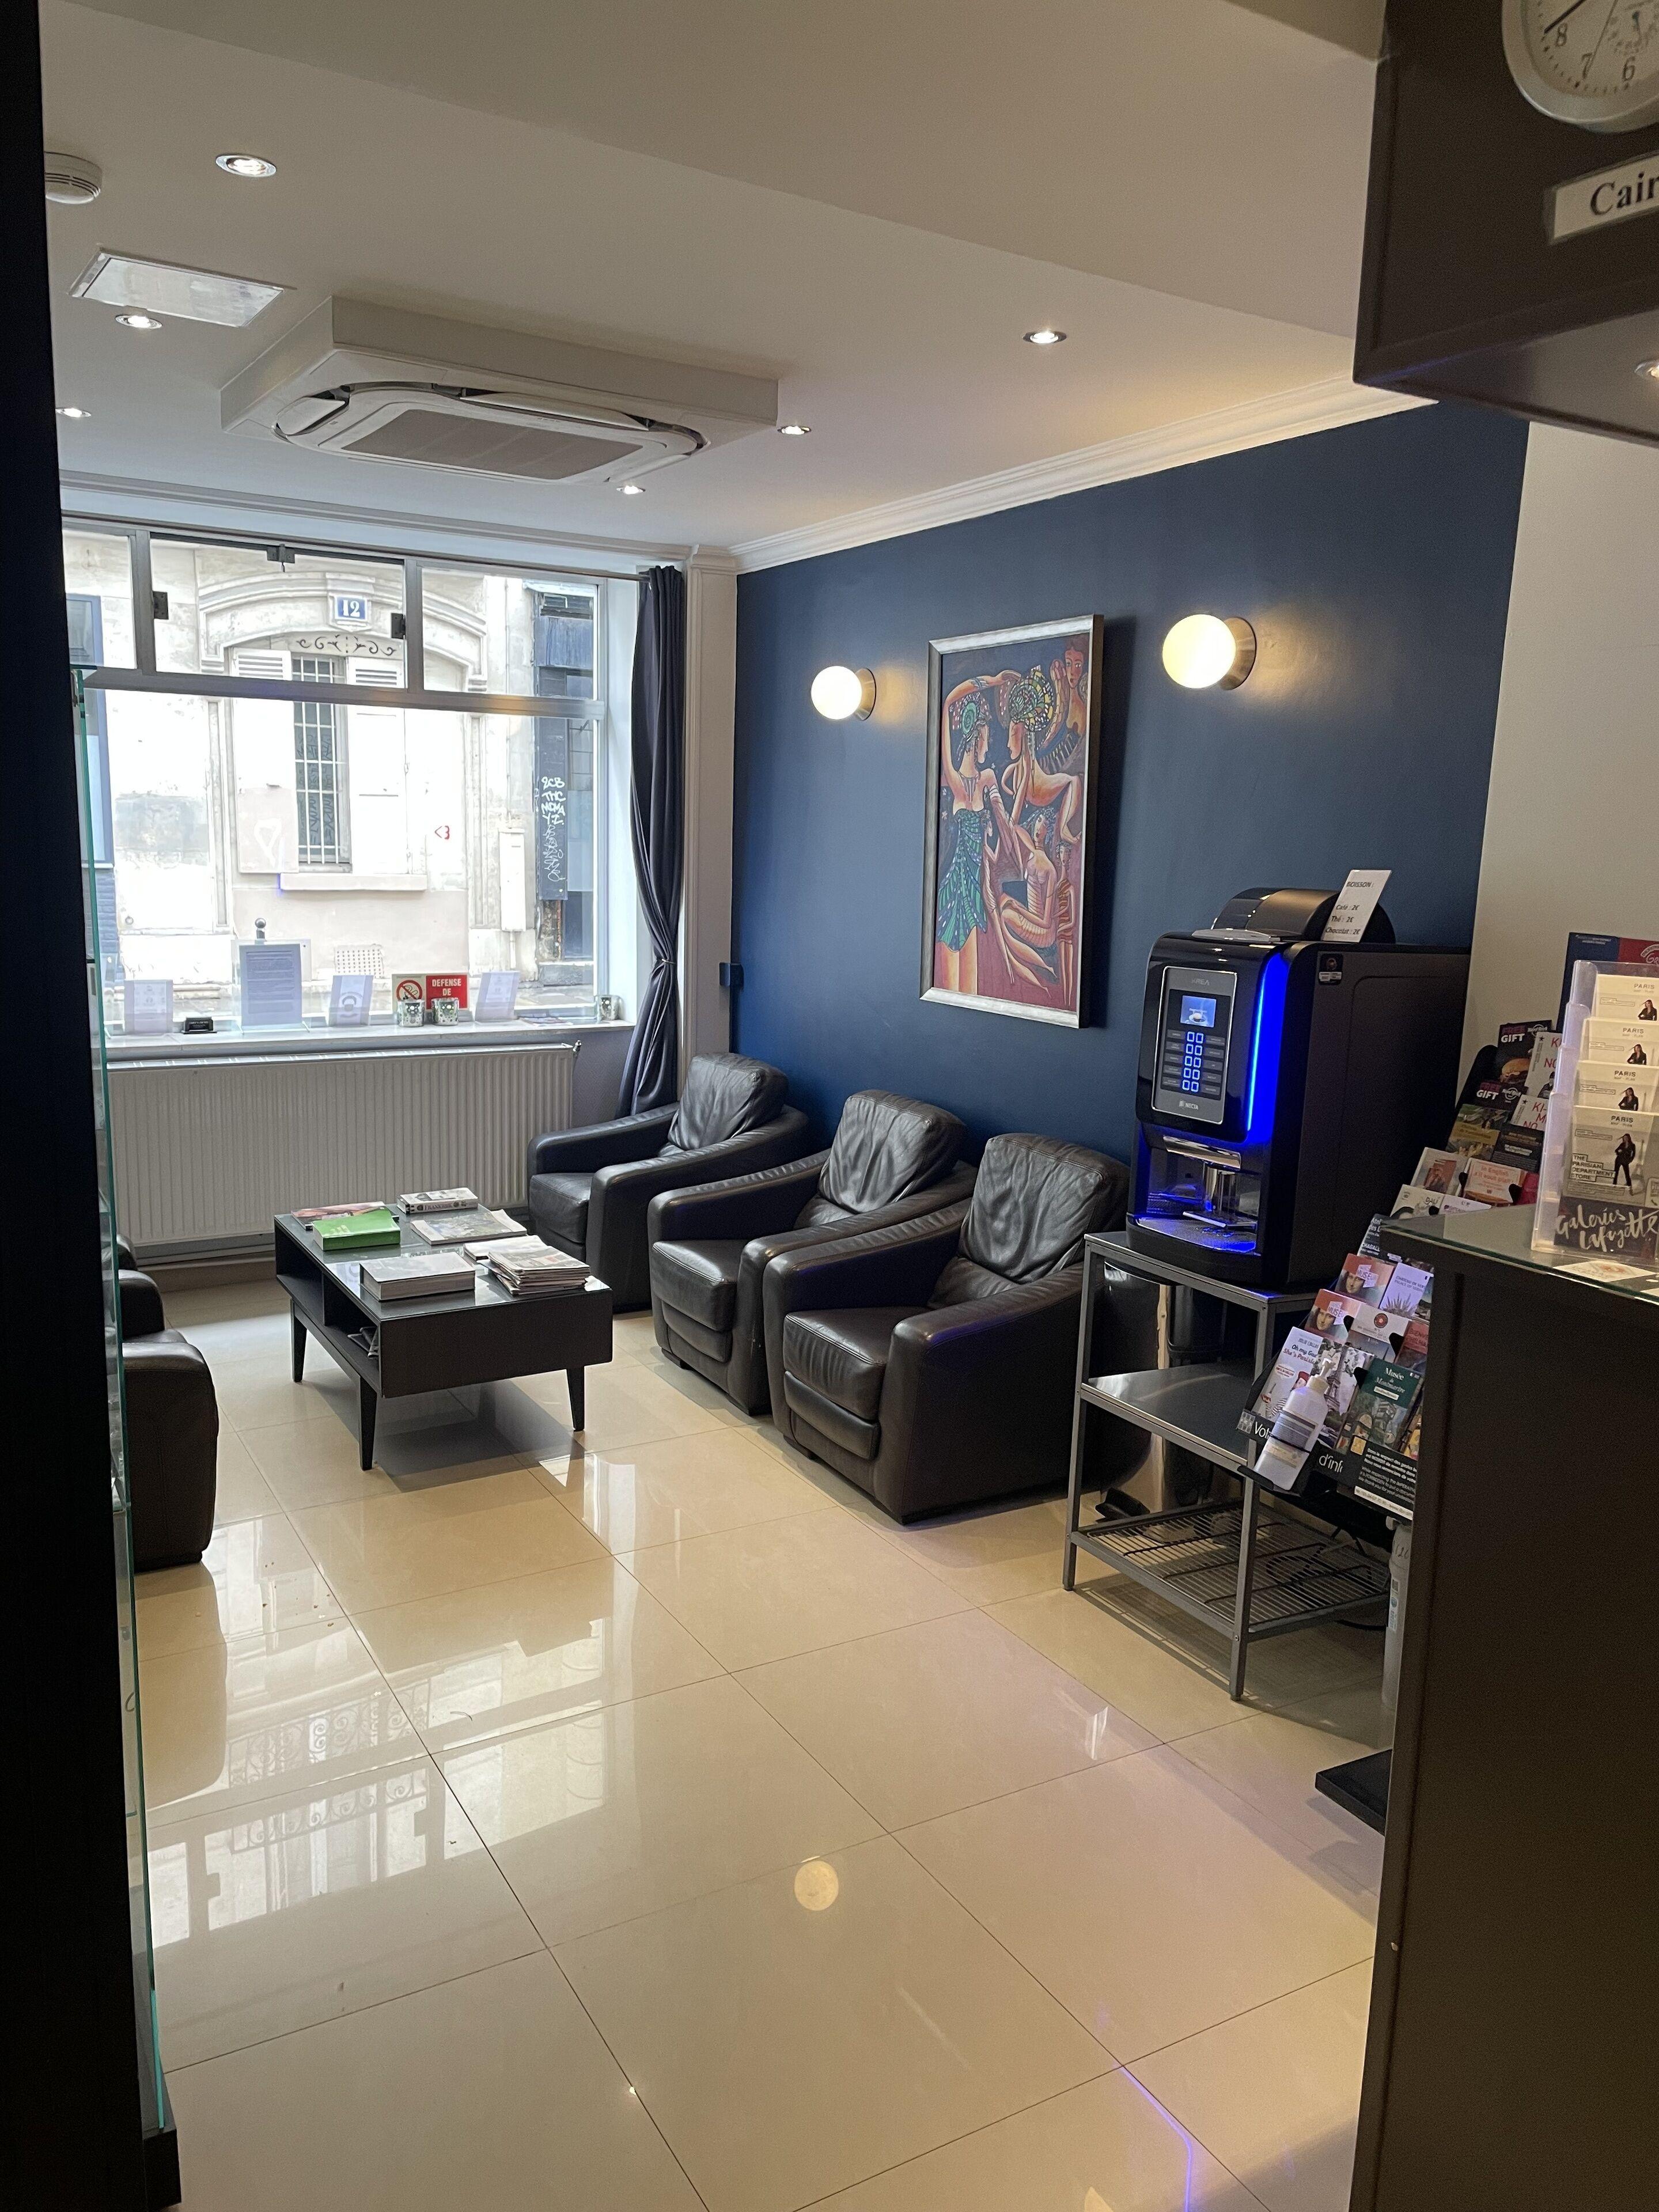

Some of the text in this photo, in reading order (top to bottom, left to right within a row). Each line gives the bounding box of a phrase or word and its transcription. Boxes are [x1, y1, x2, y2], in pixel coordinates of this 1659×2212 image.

[1555, 22, 1567, 48] 8
[1581, 53, 1593, 80] 7
[1622, 56, 1635, 82] 6
[343, 600, 360, 618] 12
[541, 791, 566, 802] THC
[541, 801, 565, 816] MDMA
[432, 979, 461, 987] DEFENSE
[1501, 1033, 1525, 1043] GIFT
[1476, 1089, 1498, 1100] GIFT
[1611, 1115, 1634, 1123] PARIS
[1572, 1167, 1613, 1177] DEPARTMENT
[1555, 1204, 1626, 1239] Galeries
[1580, 1209, 1659, 1252] Lafayette
